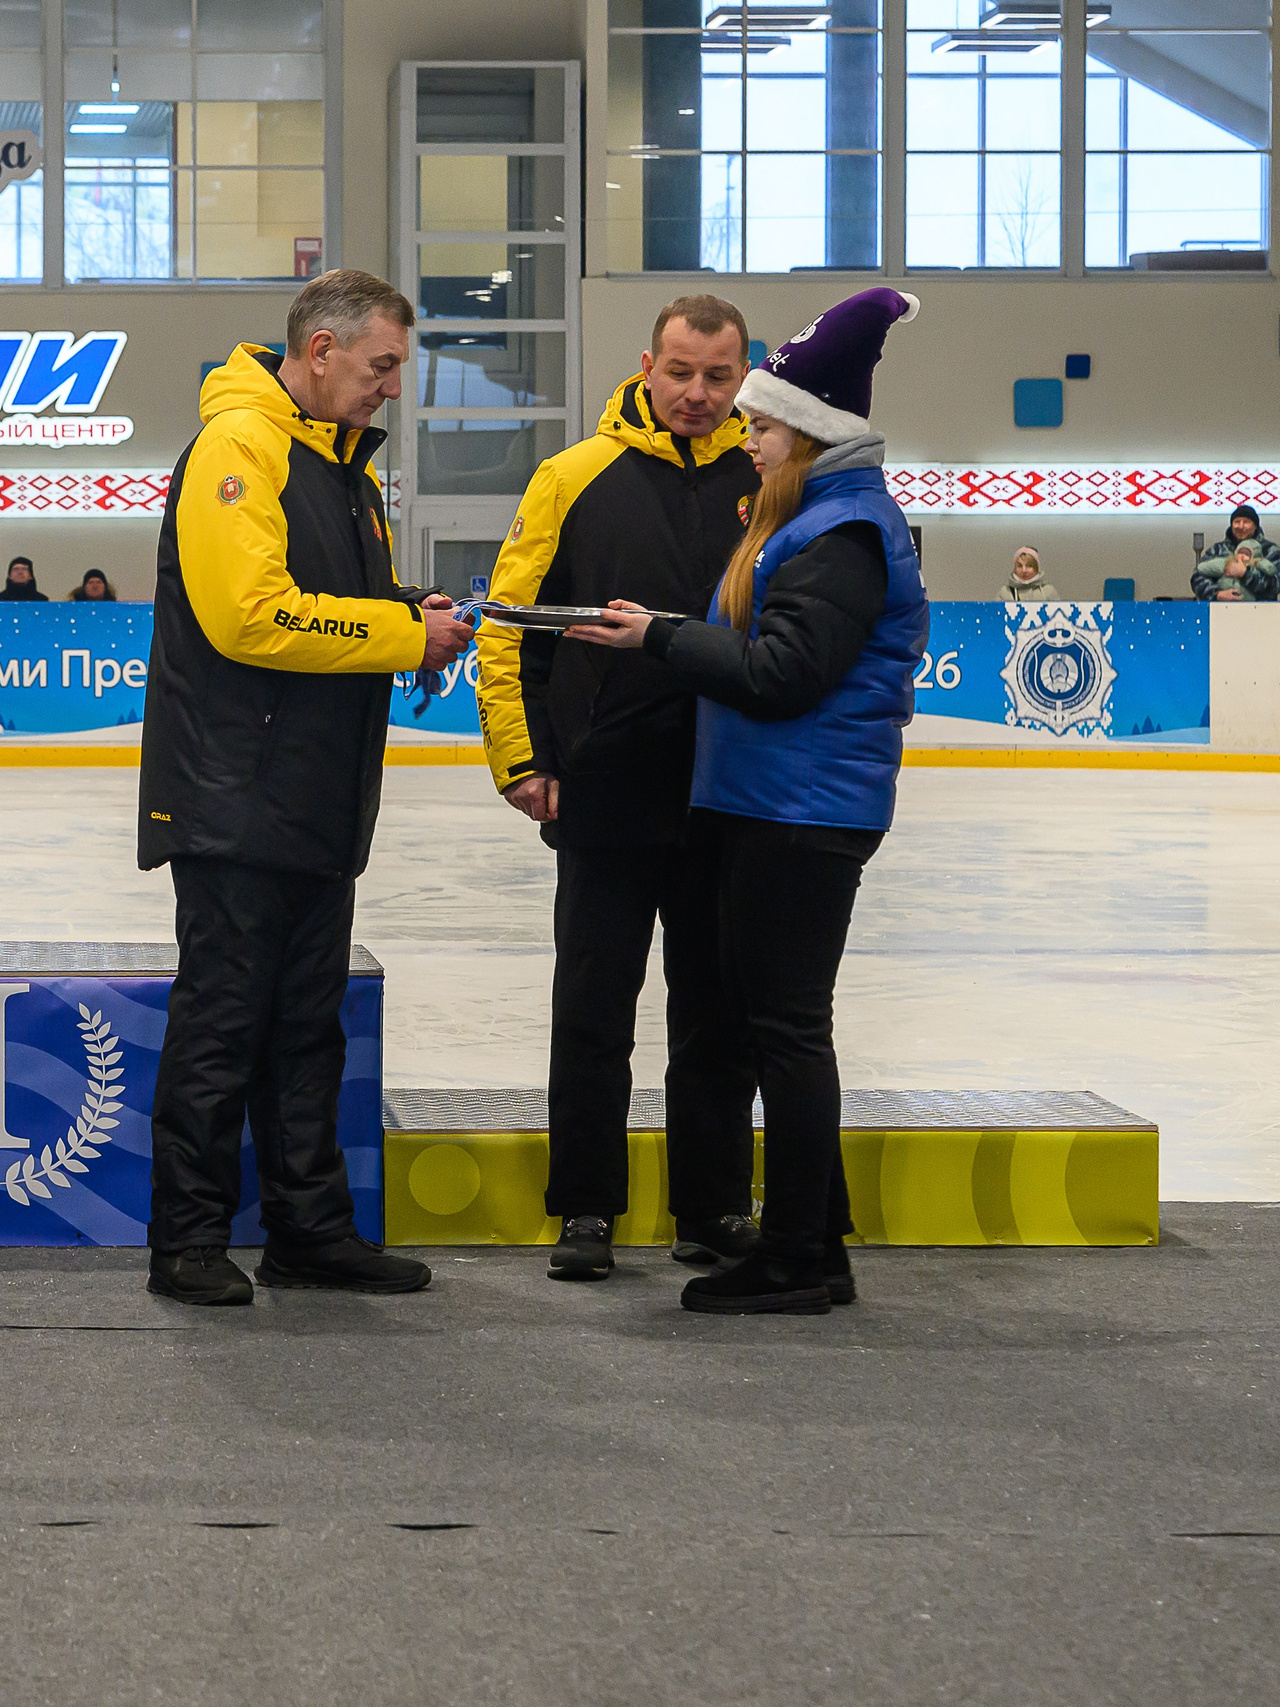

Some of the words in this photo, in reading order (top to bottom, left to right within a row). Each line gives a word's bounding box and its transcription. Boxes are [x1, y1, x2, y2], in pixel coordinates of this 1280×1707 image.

[41, 424, 127, 441] ЦЕНТР
[272, 608, 370, 640] BELARUS
[61, 648, 147, 698] Пре
